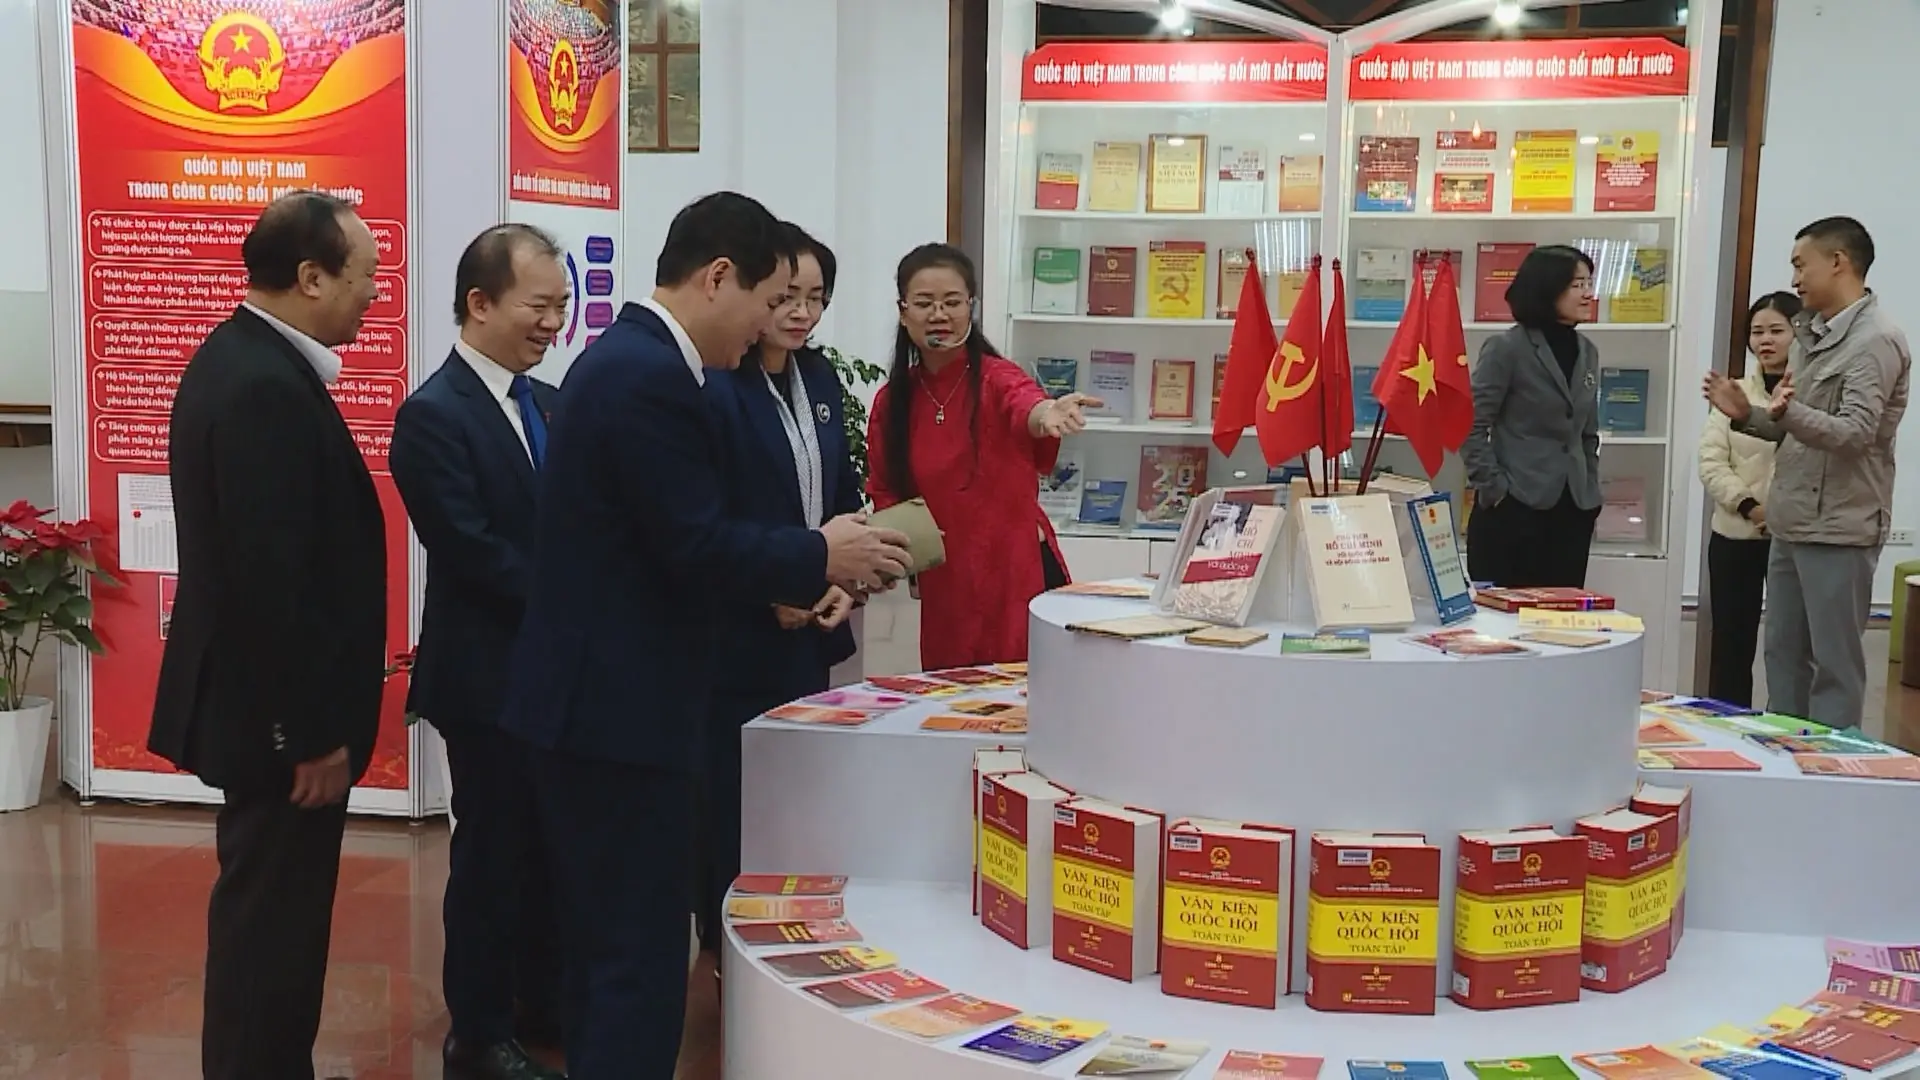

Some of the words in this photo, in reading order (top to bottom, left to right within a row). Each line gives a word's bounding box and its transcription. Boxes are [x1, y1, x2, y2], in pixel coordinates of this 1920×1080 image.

[1034, 58, 1060, 84] QUỐC
[1064, 61, 1080, 86] HỘI
[1084, 59, 1105, 86] VIỆT
[1107, 65, 1130, 82] NAM
[1134, 65, 1165, 82] TRONG
[1229, 57, 1246, 82] ĐỔI
[1250, 61, 1270, 81] MỚI
[1274, 57, 1294, 81] ĐẤT
[1297, 58, 1325, 81] NƯỚC
[1360, 55, 1388, 81] QUỐC
[1391, 57, 1408, 83] HỘI
[1412, 57, 1433, 81] VIỆT
[1438, 60, 1462, 79] NAM
[1466, 59, 1500, 78] TRONG
[1504, 54, 1532, 77] CÔNG
[1536, 55, 1565, 81] CUỘC
[1569, 50, 1587, 76] ĐỔI
[1592, 54, 1614, 76] MỚI
[1618, 51, 1639, 76] ĐẤT
[1642, 52, 1673, 75] NƯỚC
[184, 154, 217, 176] QUỐC
[222, 160, 242, 180] HỘI
[247, 160, 272, 181] VIỆT
[277, 163, 306, 177] NAM
[128, 181, 168, 199] TRONG
[172, 181, 205, 200] CÔNG
[209, 183, 243, 204] CUỘC
[247, 180, 269, 202] ĐỔI
[114, 218, 133, 228] chức
[135, 219, 146, 230] bộ
[149, 220, 166, 231] máy
[169, 220, 190, 232] được
[226, 222, 243, 234] hợp
[102, 231, 120, 241] hiệu
[141, 231, 158, 243] chất
[160, 232, 184, 244] lượng
[186, 233, 198, 244] đại
[131, 245, 152, 255] được
[153, 246, 174, 255] nâng
[103, 270, 122, 279] Phát
[123, 270, 139, 281] huy
[141, 270, 156, 280] dân
[175, 272, 197, 283] trong
[199, 273, 217, 284] hoạt
[219, 273, 240, 285] động
[103, 282, 122, 293] luận
[124, 282, 145, 294] được
[189, 284, 209, 296] công
[104, 295, 126, 304] Nhân
[127, 296, 143, 305] dân
[144, 296, 165, 308] được
[205, 298, 225, 309] ngày
[104, 321, 129, 331] Quyết
[131, 321, 150, 332] định
[151, 322, 178, 334] những
[371, 332, 392, 340] bước
[105, 346, 124, 355] phát
[121, 334, 142, 345] dựng
[144, 335, 154, 343] và
[156, 336, 177, 344] hoàn
[349, 343, 362, 352] đổi
[364, 344, 380, 353] mới
[382, 346, 392, 354] và
[106, 372, 117, 381] Hệ
[119, 372, 144, 384] thống
[145, 372, 164, 382] hiến
[372, 384, 392, 394] sung
[106, 384, 125, 392] theo
[127, 384, 154, 395] hướng
[347, 395, 356, 404] và
[140, 397, 151, 408] hội
[130, 423, 156, 434] cường
[132, 435, 153, 446] nâng
[131, 447, 151, 458] công
[1326, 540, 1338, 550] HỒ
[1341, 540, 1356, 549] CHÍ
[1360, 540, 1382, 548] MINH
[1063, 867, 1088, 882] VĂN
[1093, 875, 1121, 893] KIỆN
[1063, 881, 1094, 900] QUỐC
[1098, 891, 1120, 908] HỘI
[1181, 895, 1213, 910] VĂN
[1222, 897, 1258, 915] KIỆN
[1494, 905, 1524, 920] VĂN
[1532, 903, 1564, 917] KIỆN
[1180, 911, 1224, 928] QUỐC
[1229, 918, 1258, 932] HỘI
[1337, 910, 1372, 922] VĂN
[1382, 910, 1420, 926] KIỆN
[1337, 924, 1384, 940] QUỐC
[1389, 928, 1420, 942] HỘI
[1492, 921, 1534, 937] QUỐC
[1538, 919, 1563, 932] HỘI
[1192, 929, 1221, 941] TOÀN
[1224, 933, 1245, 944] TẬP
[1503, 940, 1530, 949] TOÀN
[1533, 936, 1551, 947] TẬP
[1349, 943, 1380, 952] TOÀN
[1383, 944, 1406, 954] TẬP
